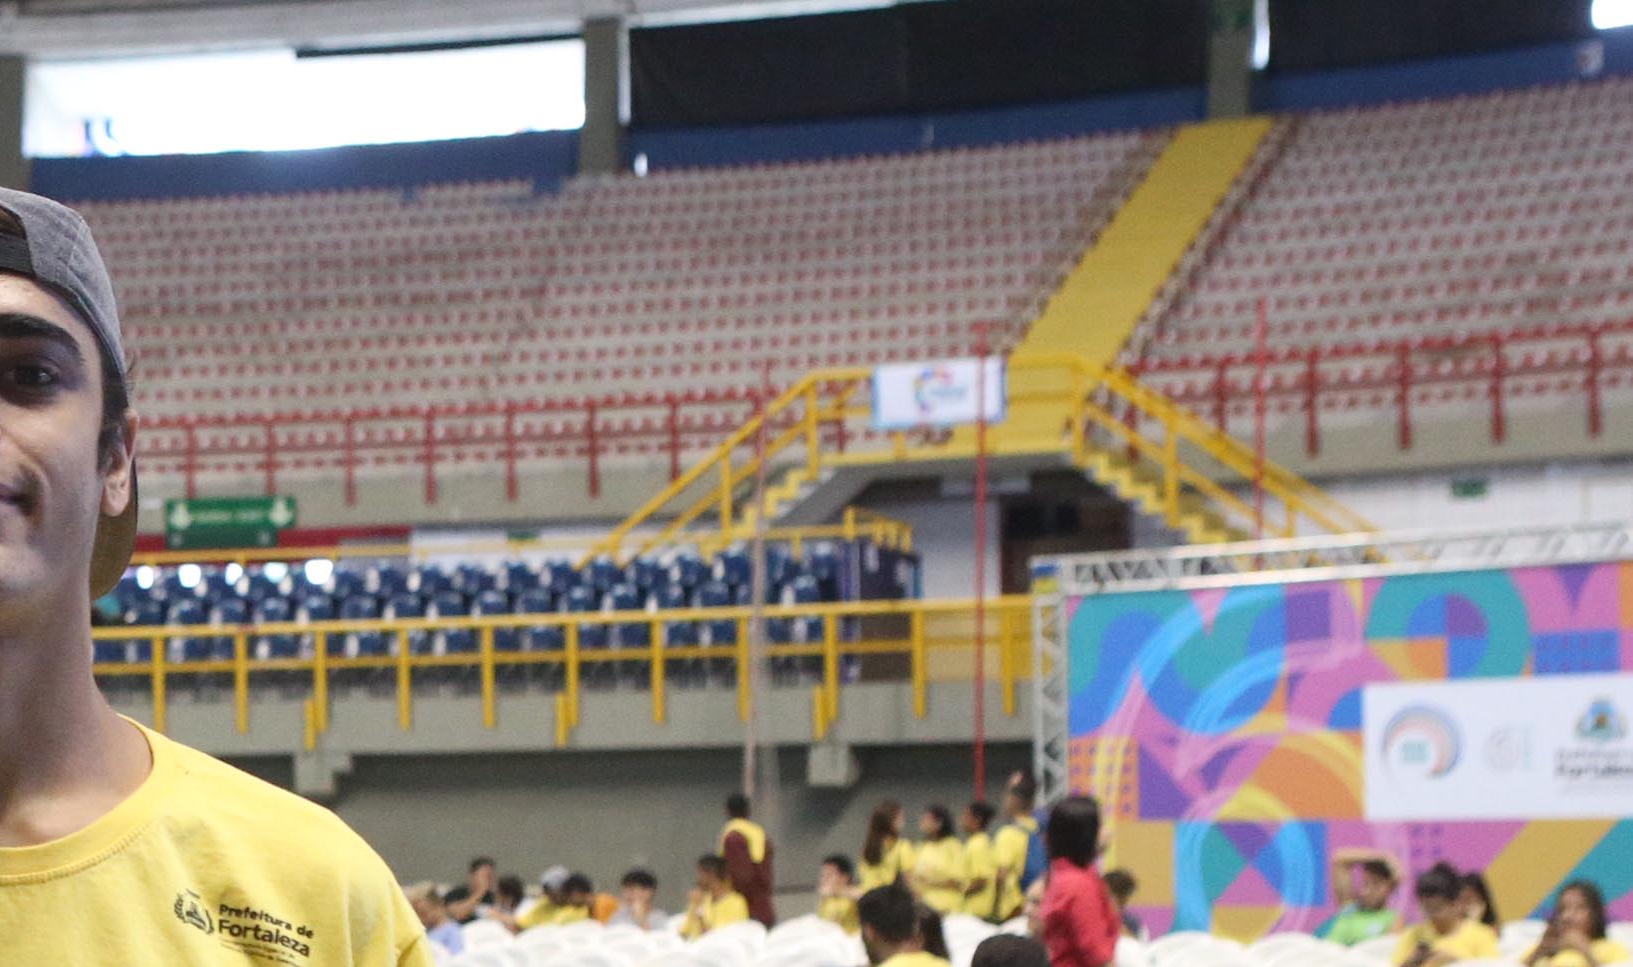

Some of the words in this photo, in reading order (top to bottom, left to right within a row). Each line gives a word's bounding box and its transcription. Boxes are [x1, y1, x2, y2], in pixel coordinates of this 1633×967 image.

[218, 903, 292, 931] Prefeitura
[296, 925, 314, 939] de
[218, 918, 311, 957] Fortaleza
